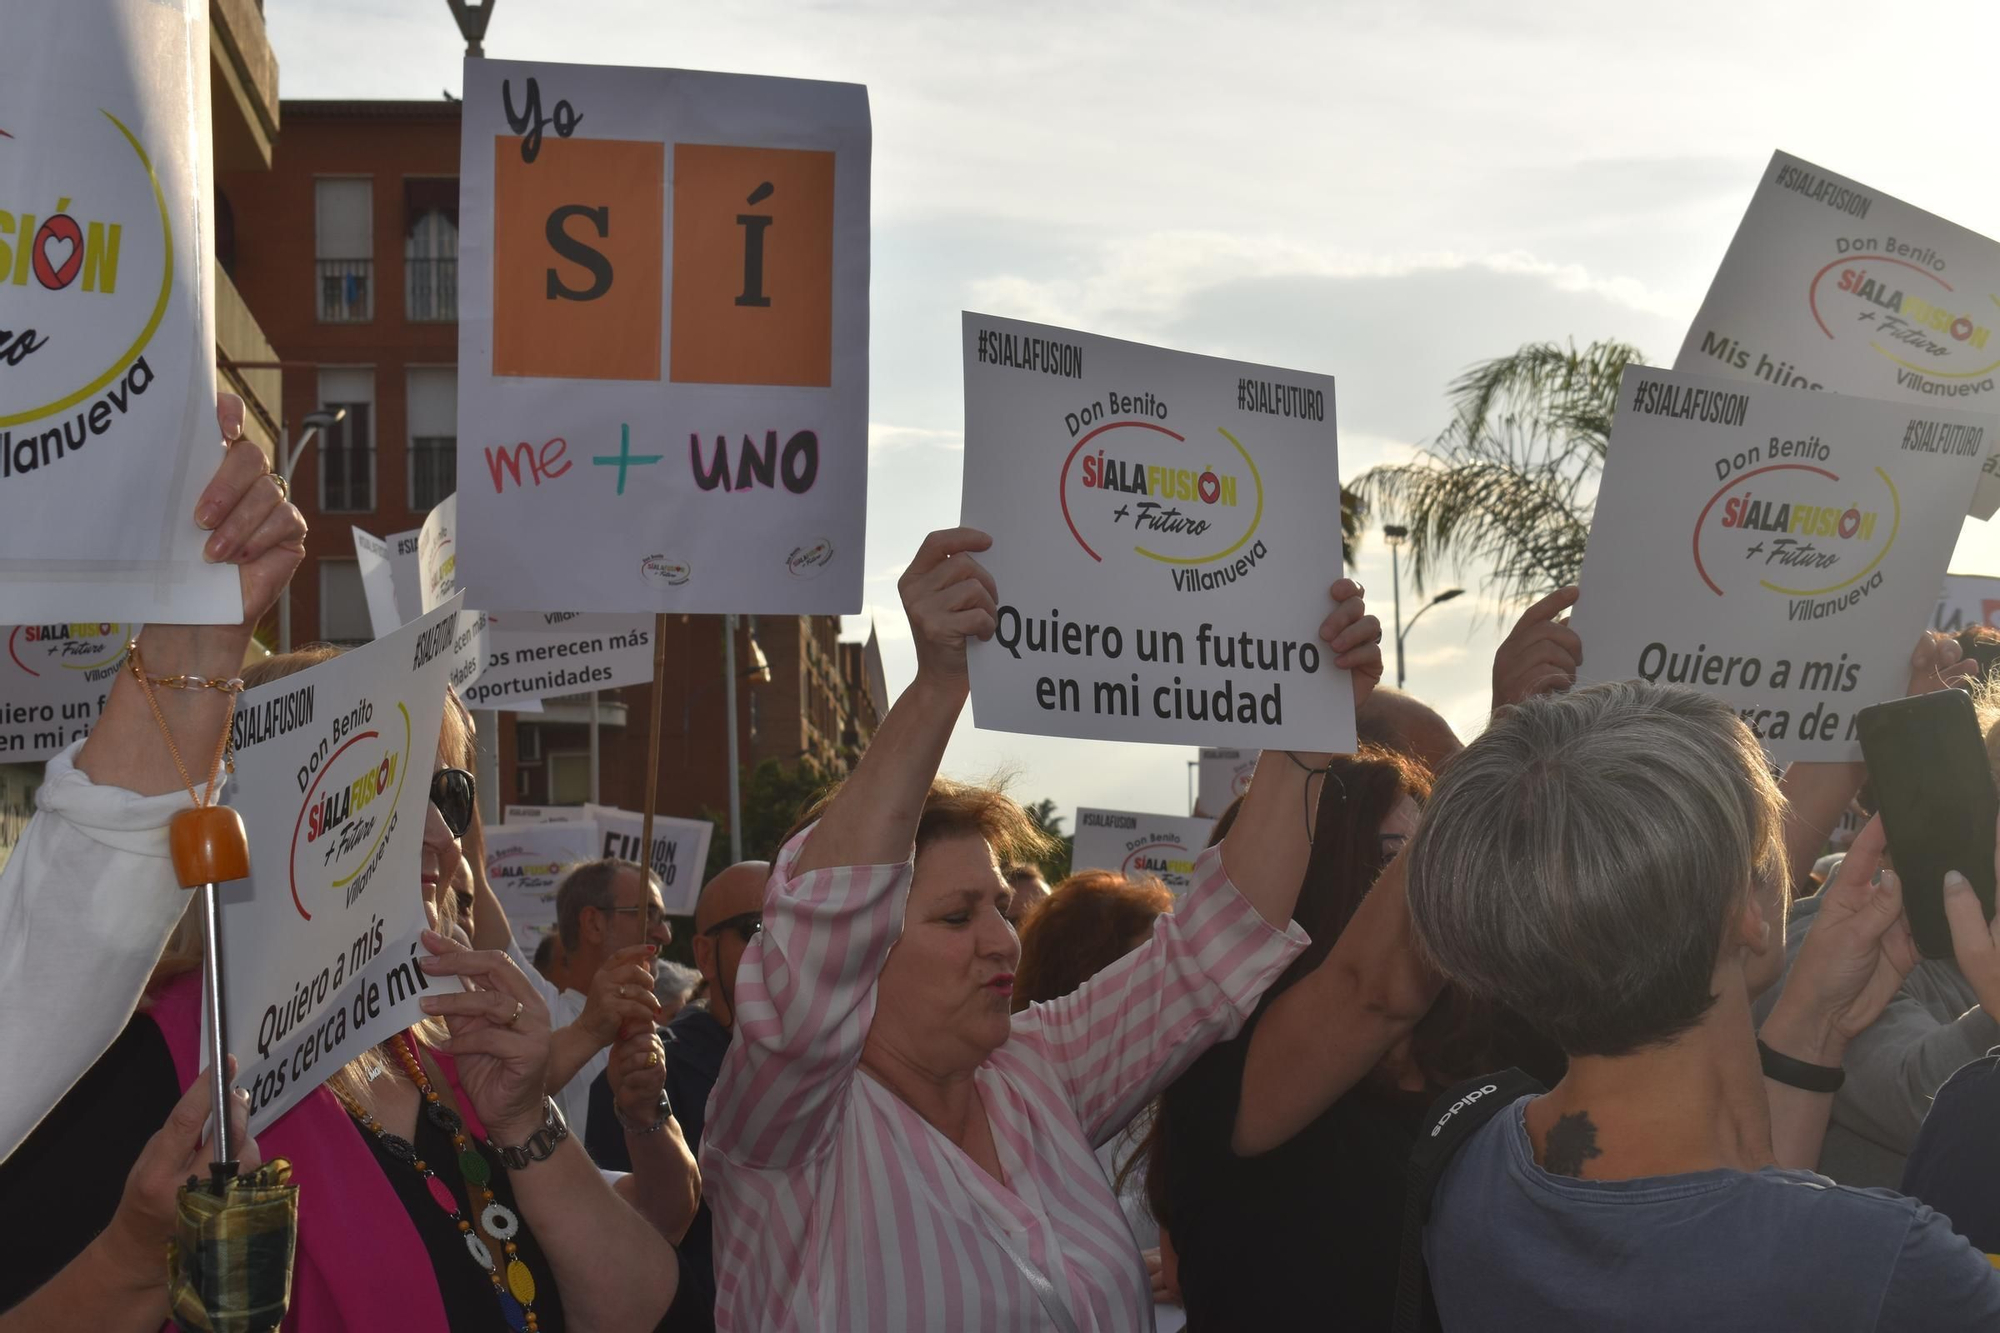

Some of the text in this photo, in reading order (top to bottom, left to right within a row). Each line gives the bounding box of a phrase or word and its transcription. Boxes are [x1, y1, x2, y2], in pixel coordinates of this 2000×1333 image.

[502, 77, 583, 163] Yo
[1775, 164, 1872, 220] #SIALAFUSION
[1836, 237, 1946, 272] Don Benito
[978, 329, 1083, 379] #SIALAFUSION
[1701, 330, 1751, 370] Mis
[1876, 315, 1951, 357] Futuro
[1237, 378, 1324, 422] #SIALFUTURO
[1633, 380, 1749, 427] #SIALAFUSION
[1896, 367, 1995, 397] Villanueva
[1065, 391, 1168, 437] Don Benito
[1715, 436, 1831, 481] Don Benito
[1901, 419, 1984, 457] #SIALFUTURO
[484, 437, 572, 494] me
[688, 429, 819, 494] UNO
[1134, 502, 1212, 536] Futuro
[1171, 539, 1268, 592] Villanueva
[1765, 538, 1841, 569] Futuro
[1788, 570, 1884, 621] Villanueva
[61, 641, 106, 657] Futuro
[516, 637, 604, 664] merecen
[609, 629, 649, 650] más
[996, 605, 1320, 673] Quiero un futuro
[465, 664, 613, 703] oportunidades
[1638, 642, 1861, 692] Quiero a mis
[0, 703, 54, 725] iero
[62, 702, 91, 720] un
[231, 684, 315, 752] SIALAFUSION
[1035, 674, 1283, 725] en mi ciudad
[1799, 702, 1839, 741] de
[34, 727, 64, 749] mi
[297, 698, 373, 794] Don Benito
[336, 815, 377, 863] Futuro
[346, 810, 398, 909] Villanueva
[1126, 833, 1181, 851] Don Benito
[1134, 855, 1196, 874] SÍALAFUSI
[258, 914, 384, 1060] Quiero a mis
[292, 1007, 346, 1082] cerca
[353, 978, 380, 1030] de
[386, 942, 429, 1007] mí
[1431, 1084, 1498, 1137] adidas
